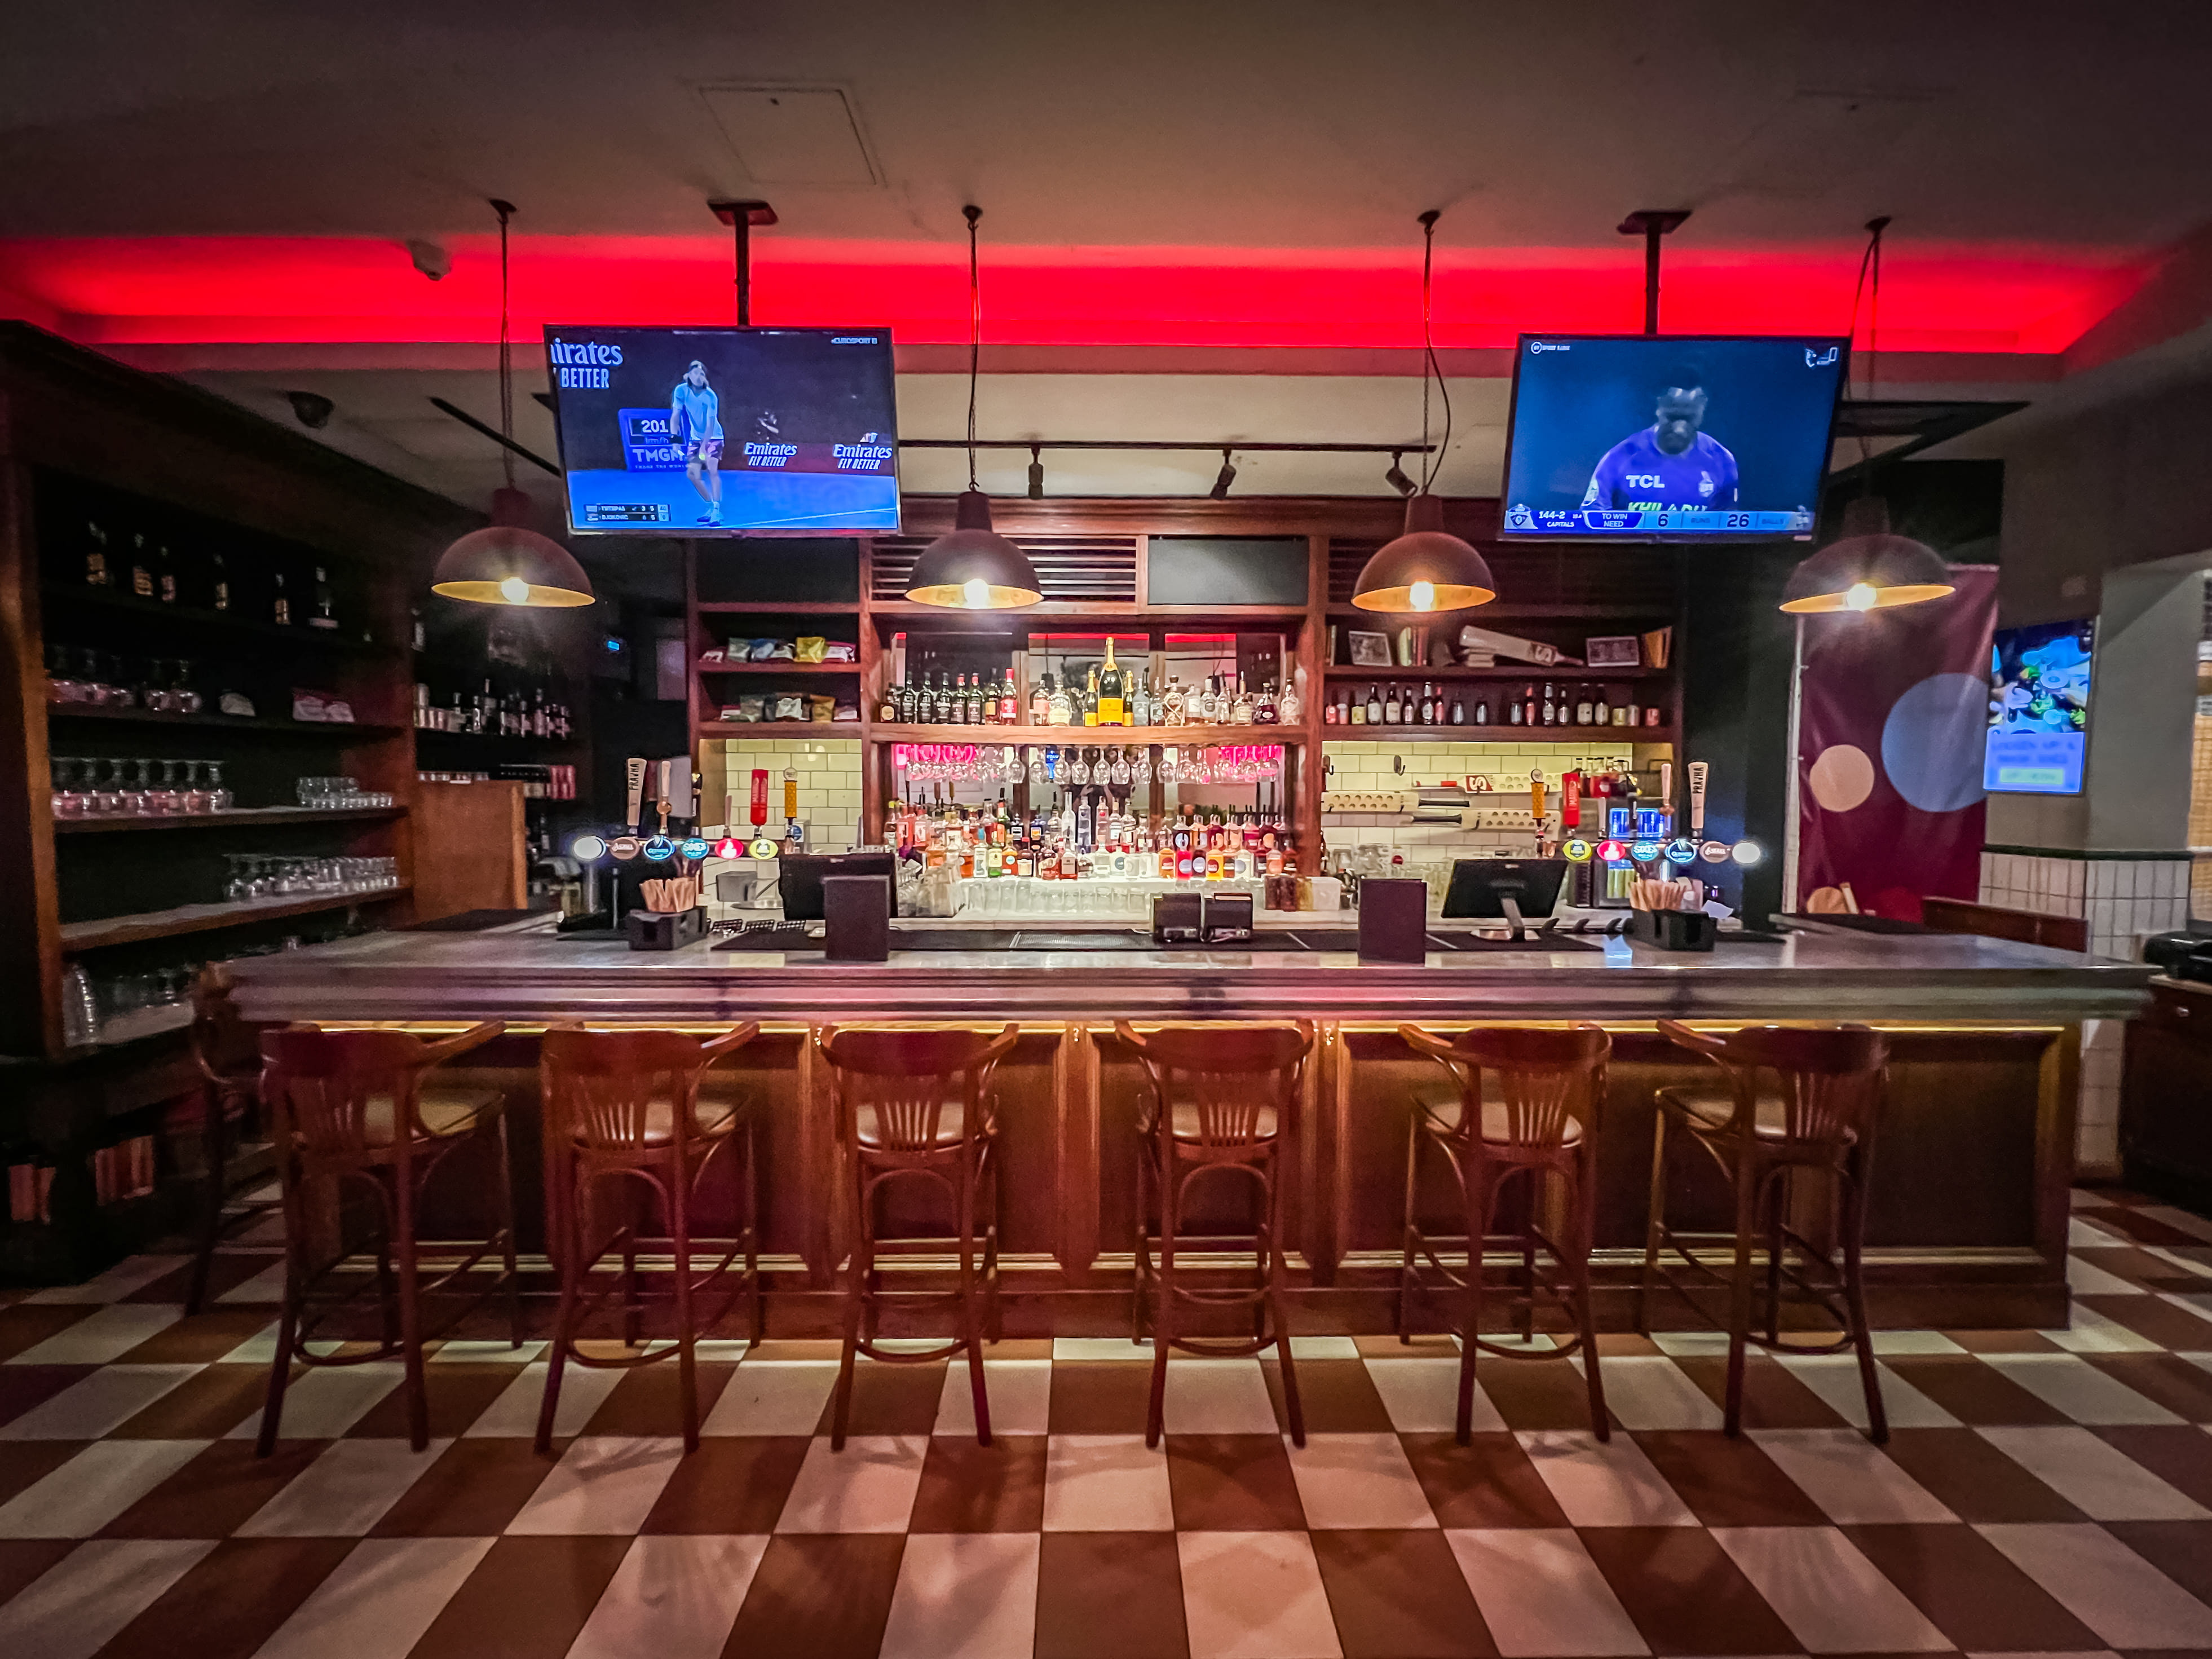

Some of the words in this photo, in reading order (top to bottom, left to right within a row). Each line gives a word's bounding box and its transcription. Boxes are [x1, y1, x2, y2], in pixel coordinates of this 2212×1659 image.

[561, 367, 610, 389] BETTER
[641, 420, 669, 433] 201
[744, 442, 798, 456] Emirates
[832, 443, 893, 458] Emirates
[838, 457, 851, 469] FLY
[1626, 474, 1665, 489] TCL
[1538, 511, 1565, 519] 144-2
[1657, 514, 1668, 527] 6
[1727, 514, 1749, 527] 26
[1692, 767, 1703, 794] PRAVHA
